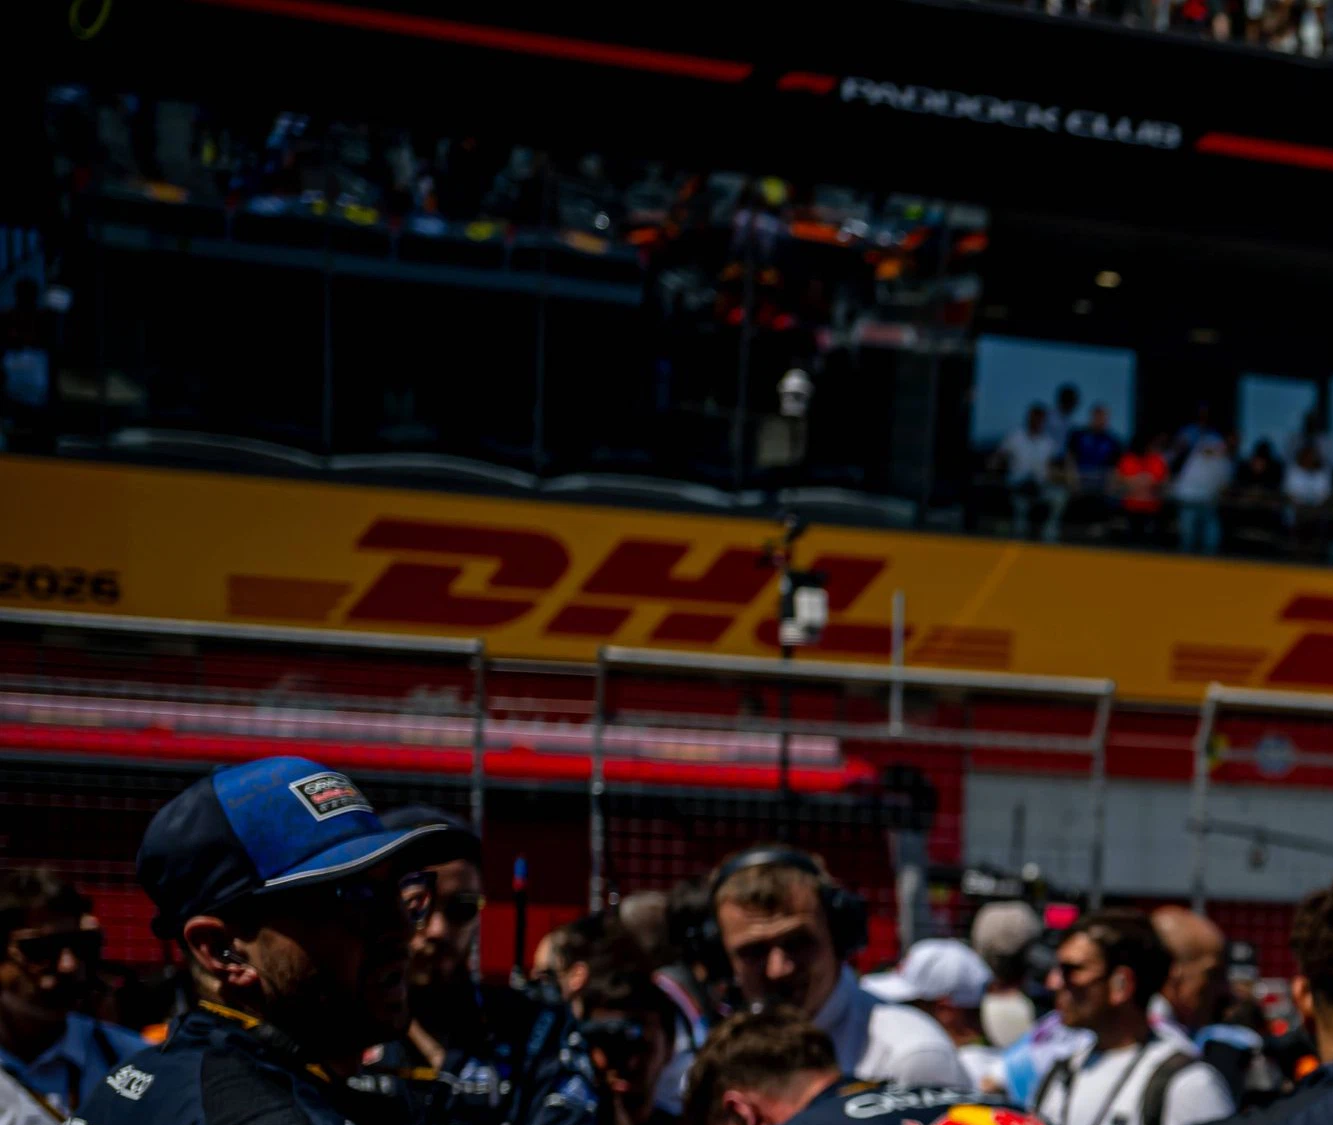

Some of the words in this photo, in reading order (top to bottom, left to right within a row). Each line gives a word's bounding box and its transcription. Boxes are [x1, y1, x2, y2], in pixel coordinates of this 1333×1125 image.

[840, 75, 1061, 133] PADDOCK
[1064, 108, 1184, 150] CLUB
[349, 519, 912, 656] DHL
